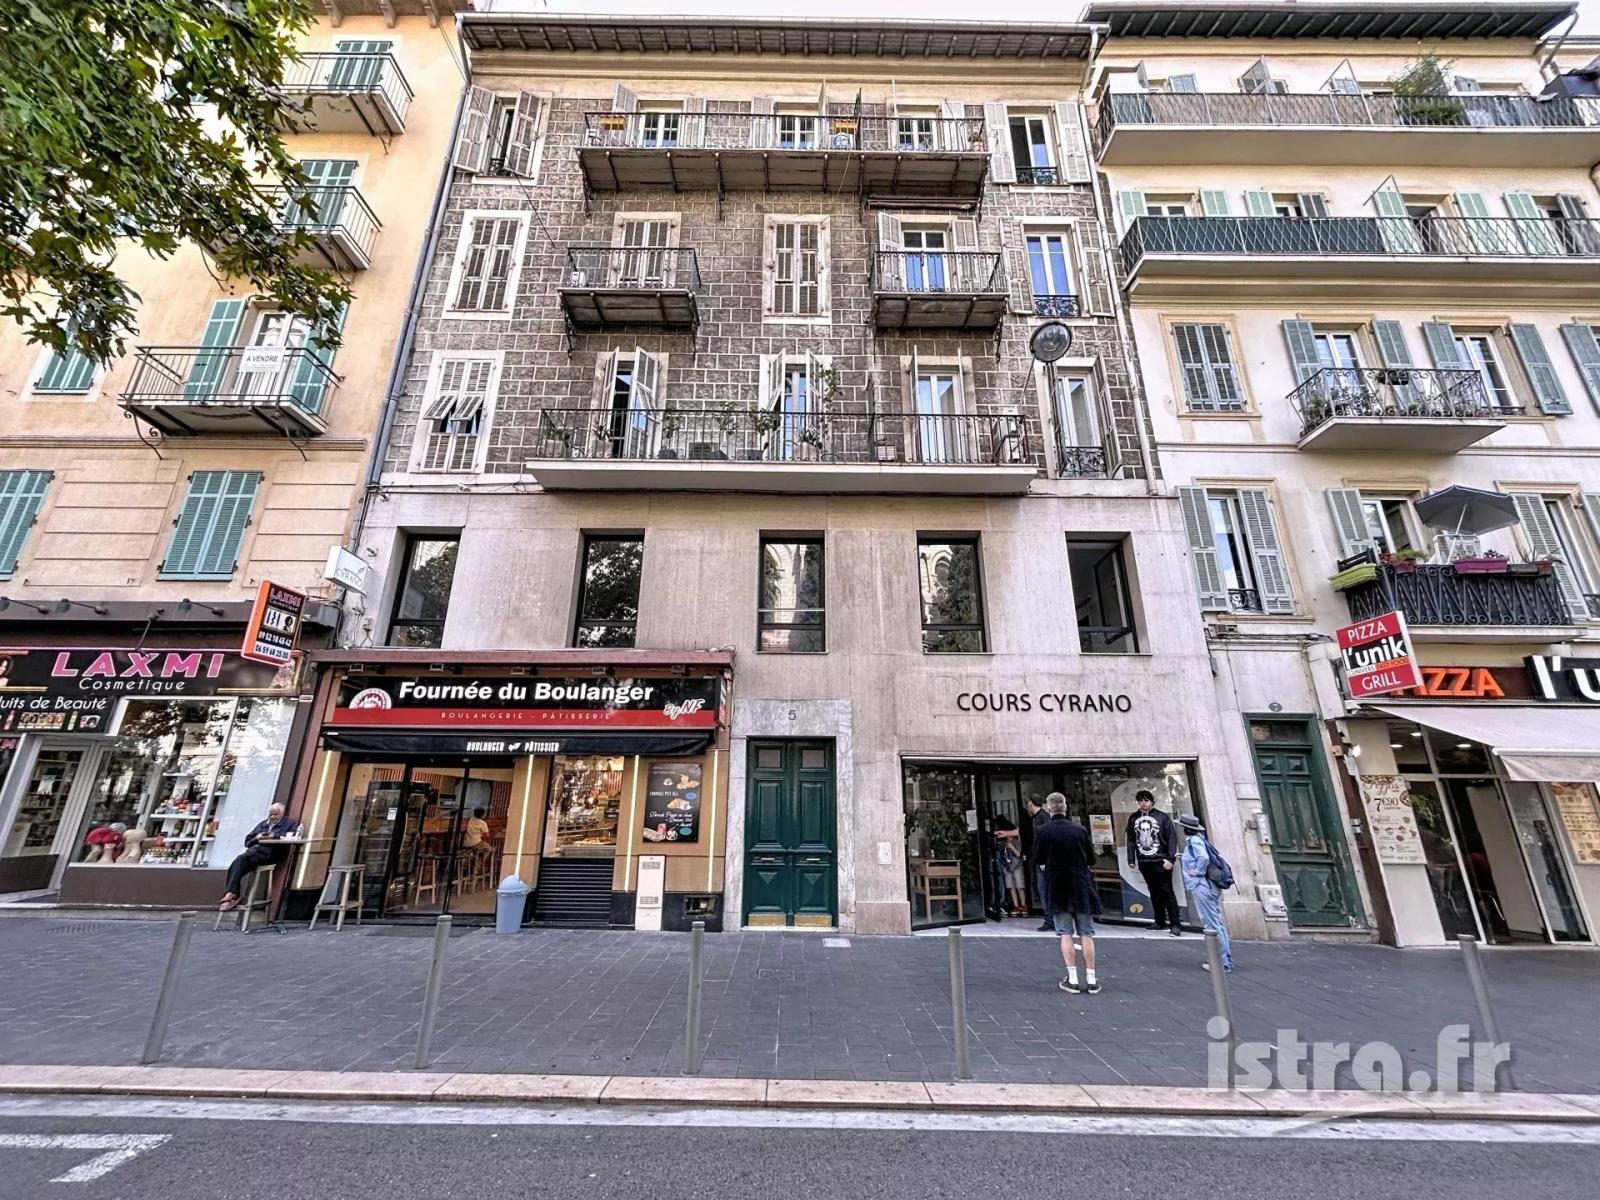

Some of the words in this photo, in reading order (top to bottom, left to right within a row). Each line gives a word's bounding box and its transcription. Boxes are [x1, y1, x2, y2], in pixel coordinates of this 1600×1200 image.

[269, 588, 301, 607] LAXMI
[1347, 620, 1388, 643] PIZZA
[1342, 636, 1408, 670] l'unik
[51, 652, 224, 678] LAXMI
[78, 677, 186, 691] Cosmetique
[1362, 671, 1402, 690] GRILL
[399, 681, 493, 700] Fournée
[498, 682, 526, 700] du
[534, 683, 654, 704] Boulanger
[29, 696, 50, 709] de
[54, 696, 107, 709] Beauté
[662, 702, 682, 720] By
[680, 698, 705, 716] NF
[957, 693, 1032, 712] COURS
[1039, 693, 1132, 713] CYRANO
[441, 712, 523, 720] BOULANGERIE
[789, 709, 796, 720] 5
